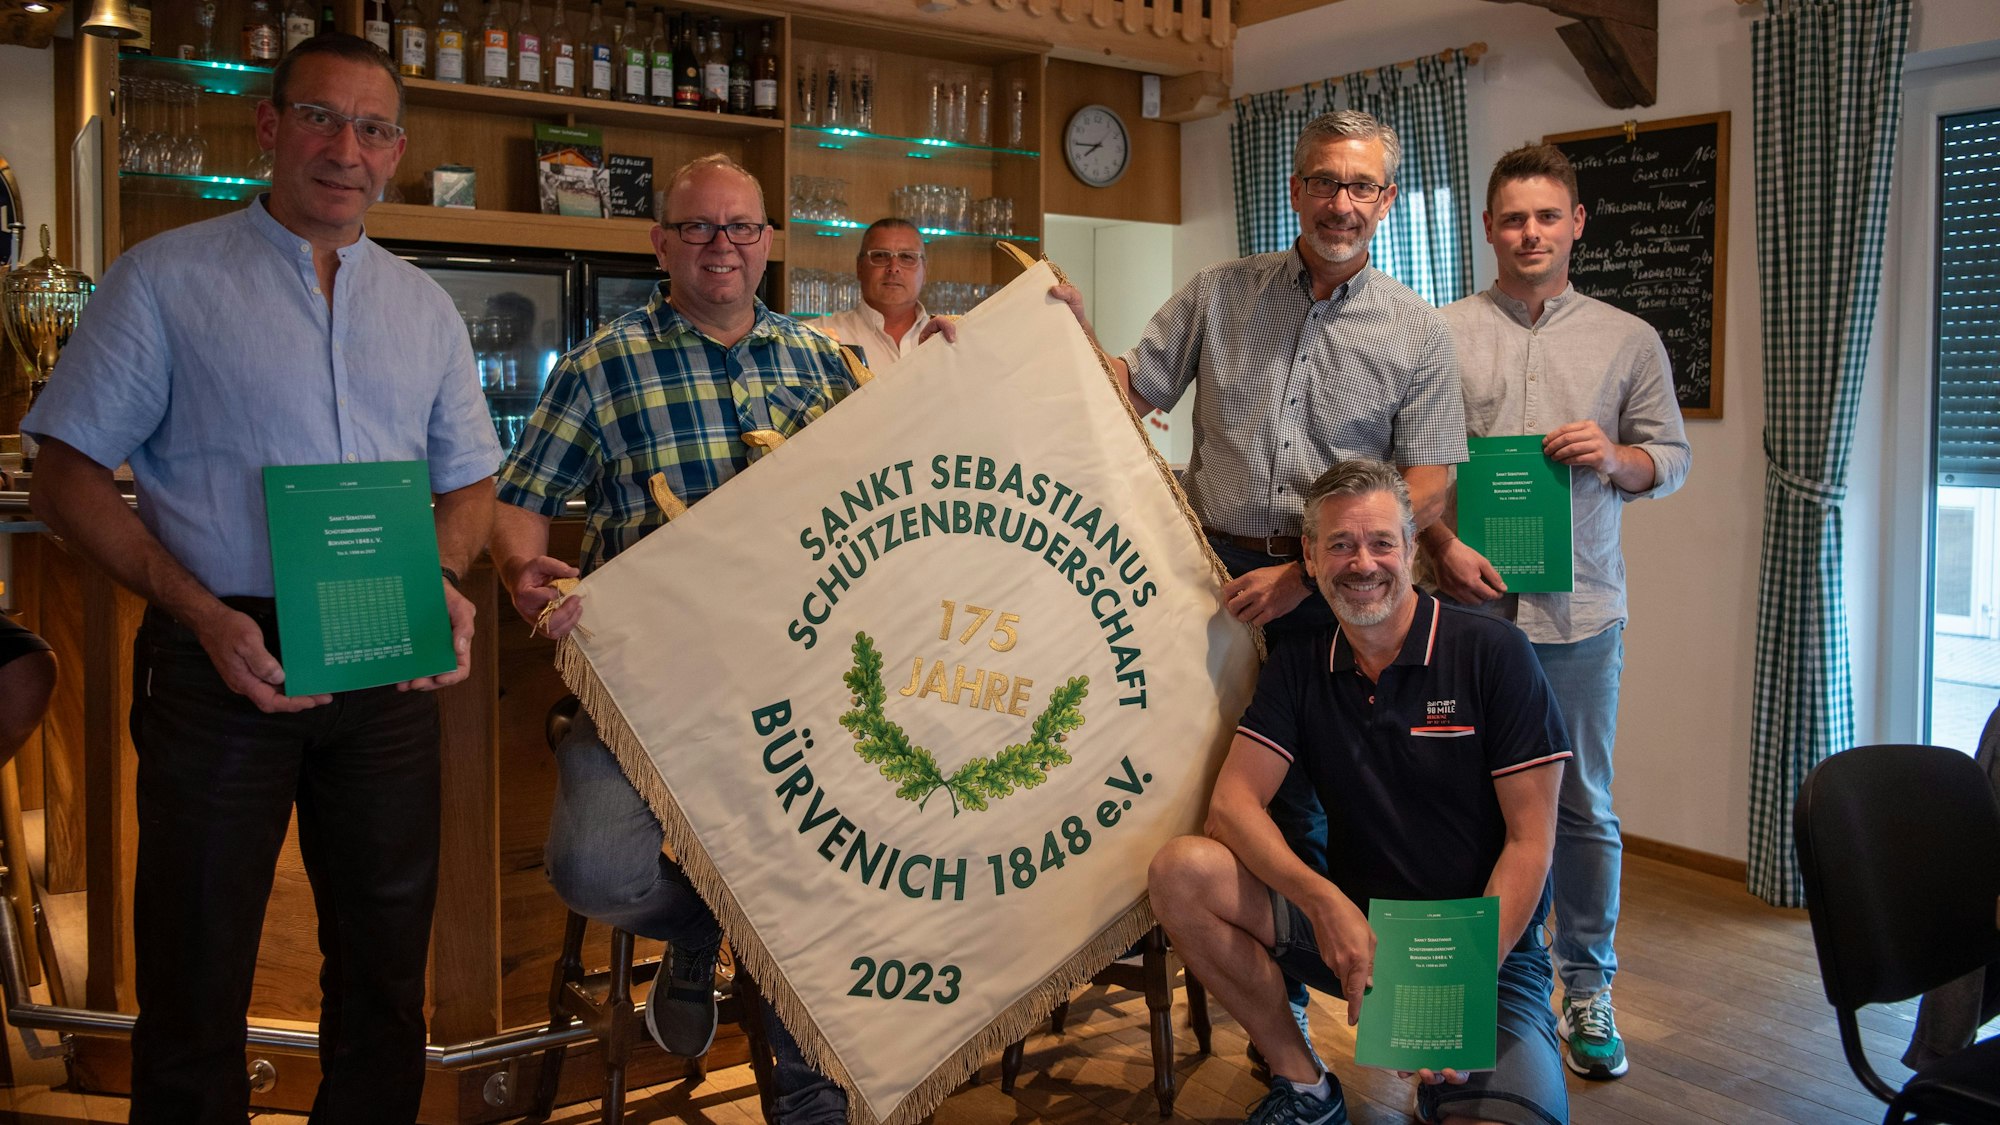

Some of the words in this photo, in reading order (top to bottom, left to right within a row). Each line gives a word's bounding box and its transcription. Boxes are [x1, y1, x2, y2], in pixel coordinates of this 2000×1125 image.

[800, 460, 914, 561] SANKT
[930, 454, 1157, 608] SEBASTIANUS
[788, 500, 1147, 710] SCHÜTZENBRUDERSCHAFT
[939, 600, 1020, 652] 175
[899, 656, 1034, 718] JAHRE
[1437, 706, 1455, 714] MILE
[752, 698, 967, 900] BÜRVENICH
[988, 816, 1092, 896] 1848
[1096, 756, 1153, 828] e.V.
[847, 956, 962, 1004] 2023
